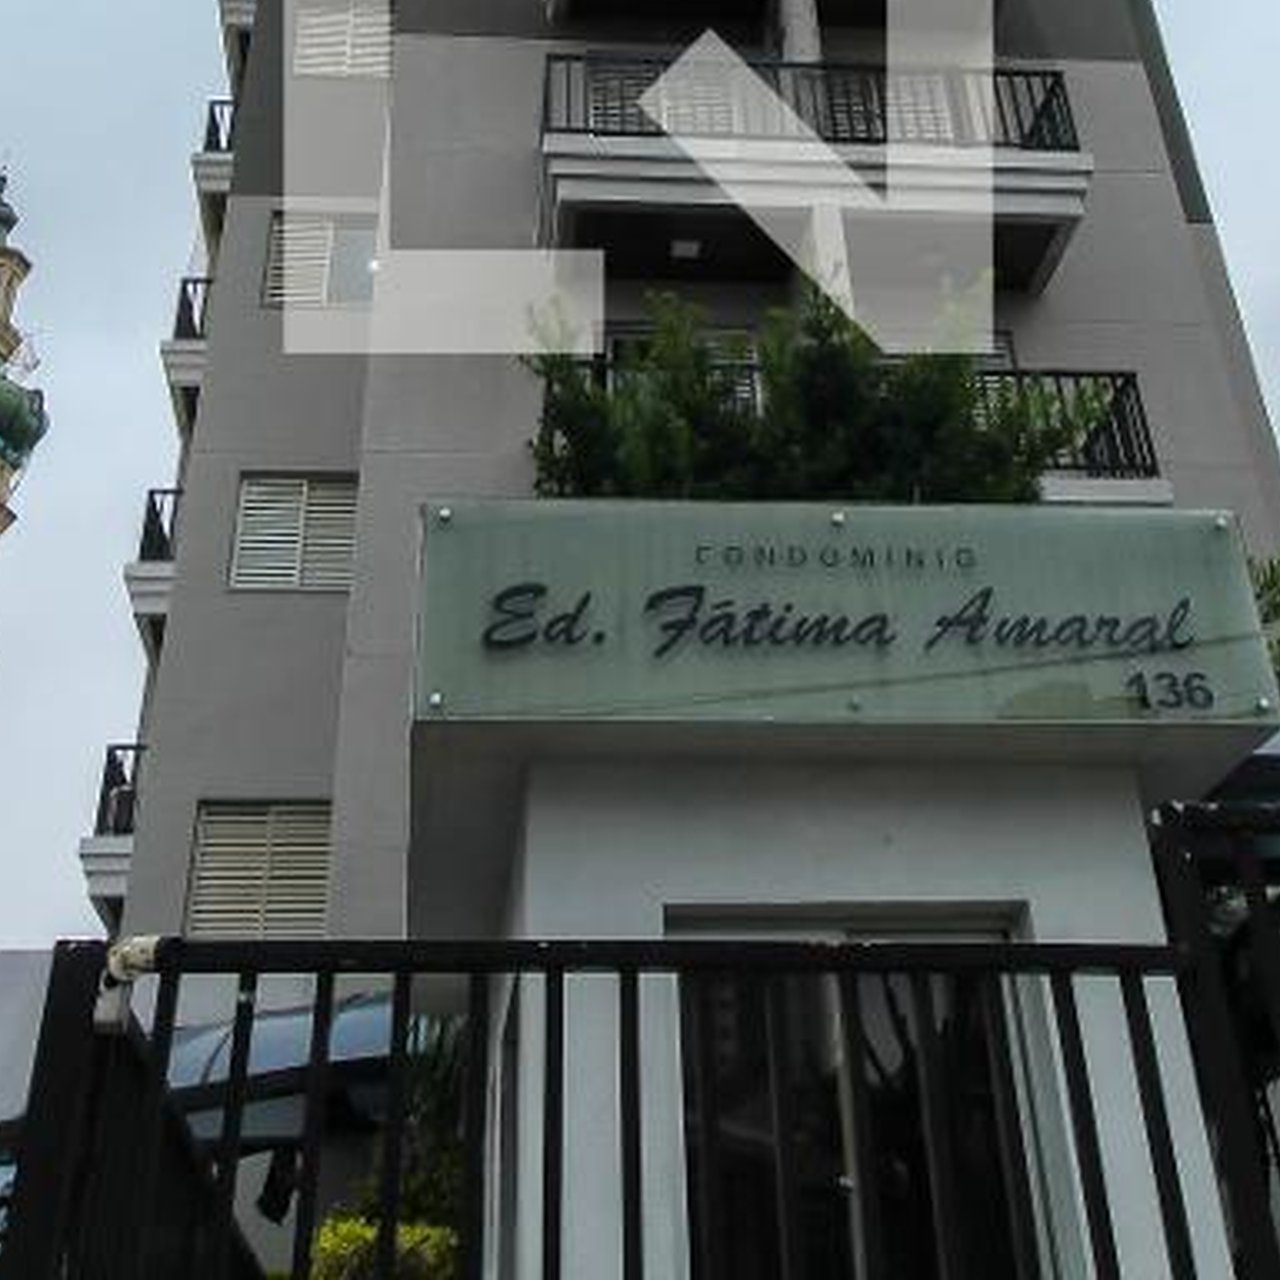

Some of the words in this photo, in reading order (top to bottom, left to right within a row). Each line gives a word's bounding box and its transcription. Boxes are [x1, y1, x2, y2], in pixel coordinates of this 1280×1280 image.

[482, 583, 605, 650] Ed.
[644, 586, 897, 658] Fátima
[925, 587, 1195, 654] Amaral
[1126, 672, 1215, 709] 136
